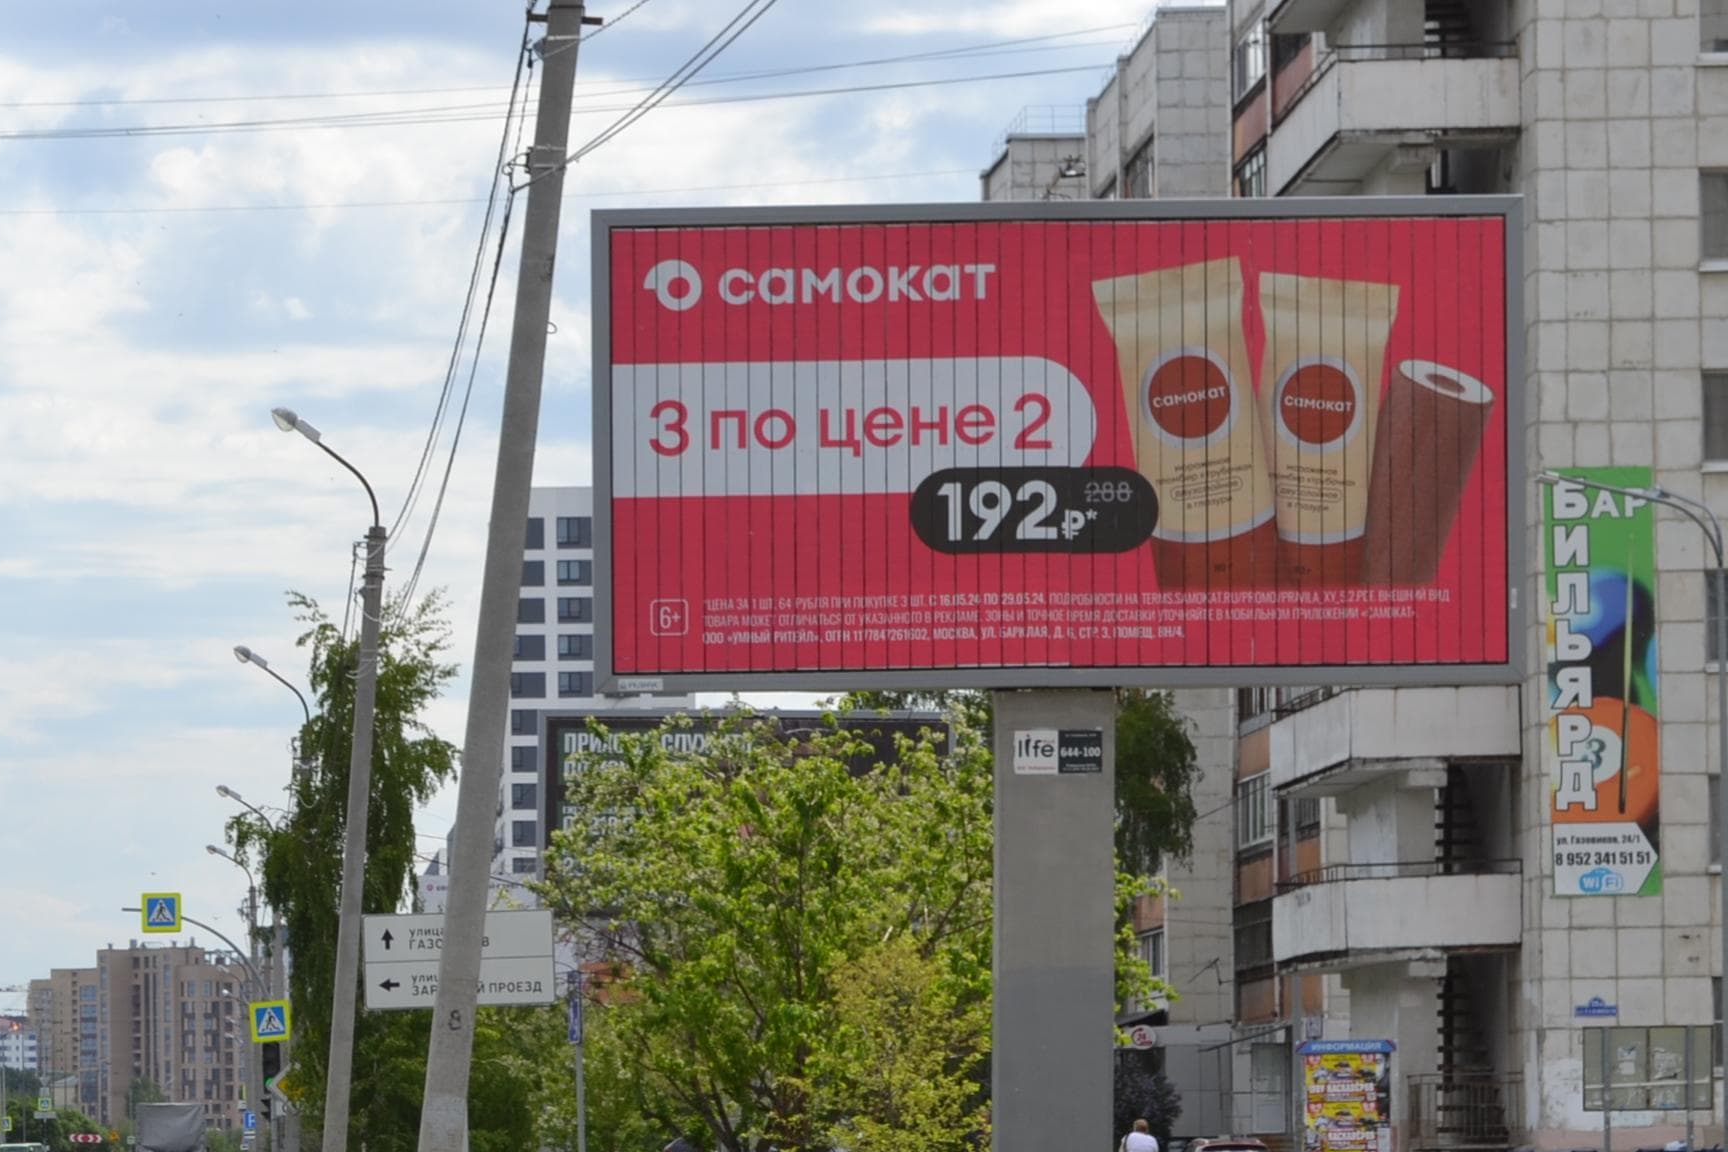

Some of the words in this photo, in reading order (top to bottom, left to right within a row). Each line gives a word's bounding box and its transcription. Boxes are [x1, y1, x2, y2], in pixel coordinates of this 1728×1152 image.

[718, 263, 996, 306] самокат
[649, 400, 690, 457] 3
[710, 408, 796, 450] по
[820, 402, 996, 458] цене
[1014, 392, 1053, 450] 2
[1083, 481, 1134, 503] 288
[659, 606, 681, 630] 6+
[1060, 746, 1101, 758] 644-100
[1555, 853, 1563, 866] 8
[1567, 852, 1591, 866] 952
[1594, 852, 1616, 865] 341
[1619, 852, 1633, 865] 51
[1636, 851, 1651, 864] 51
[489, 981, 542, 993] ПРОЕЗД
